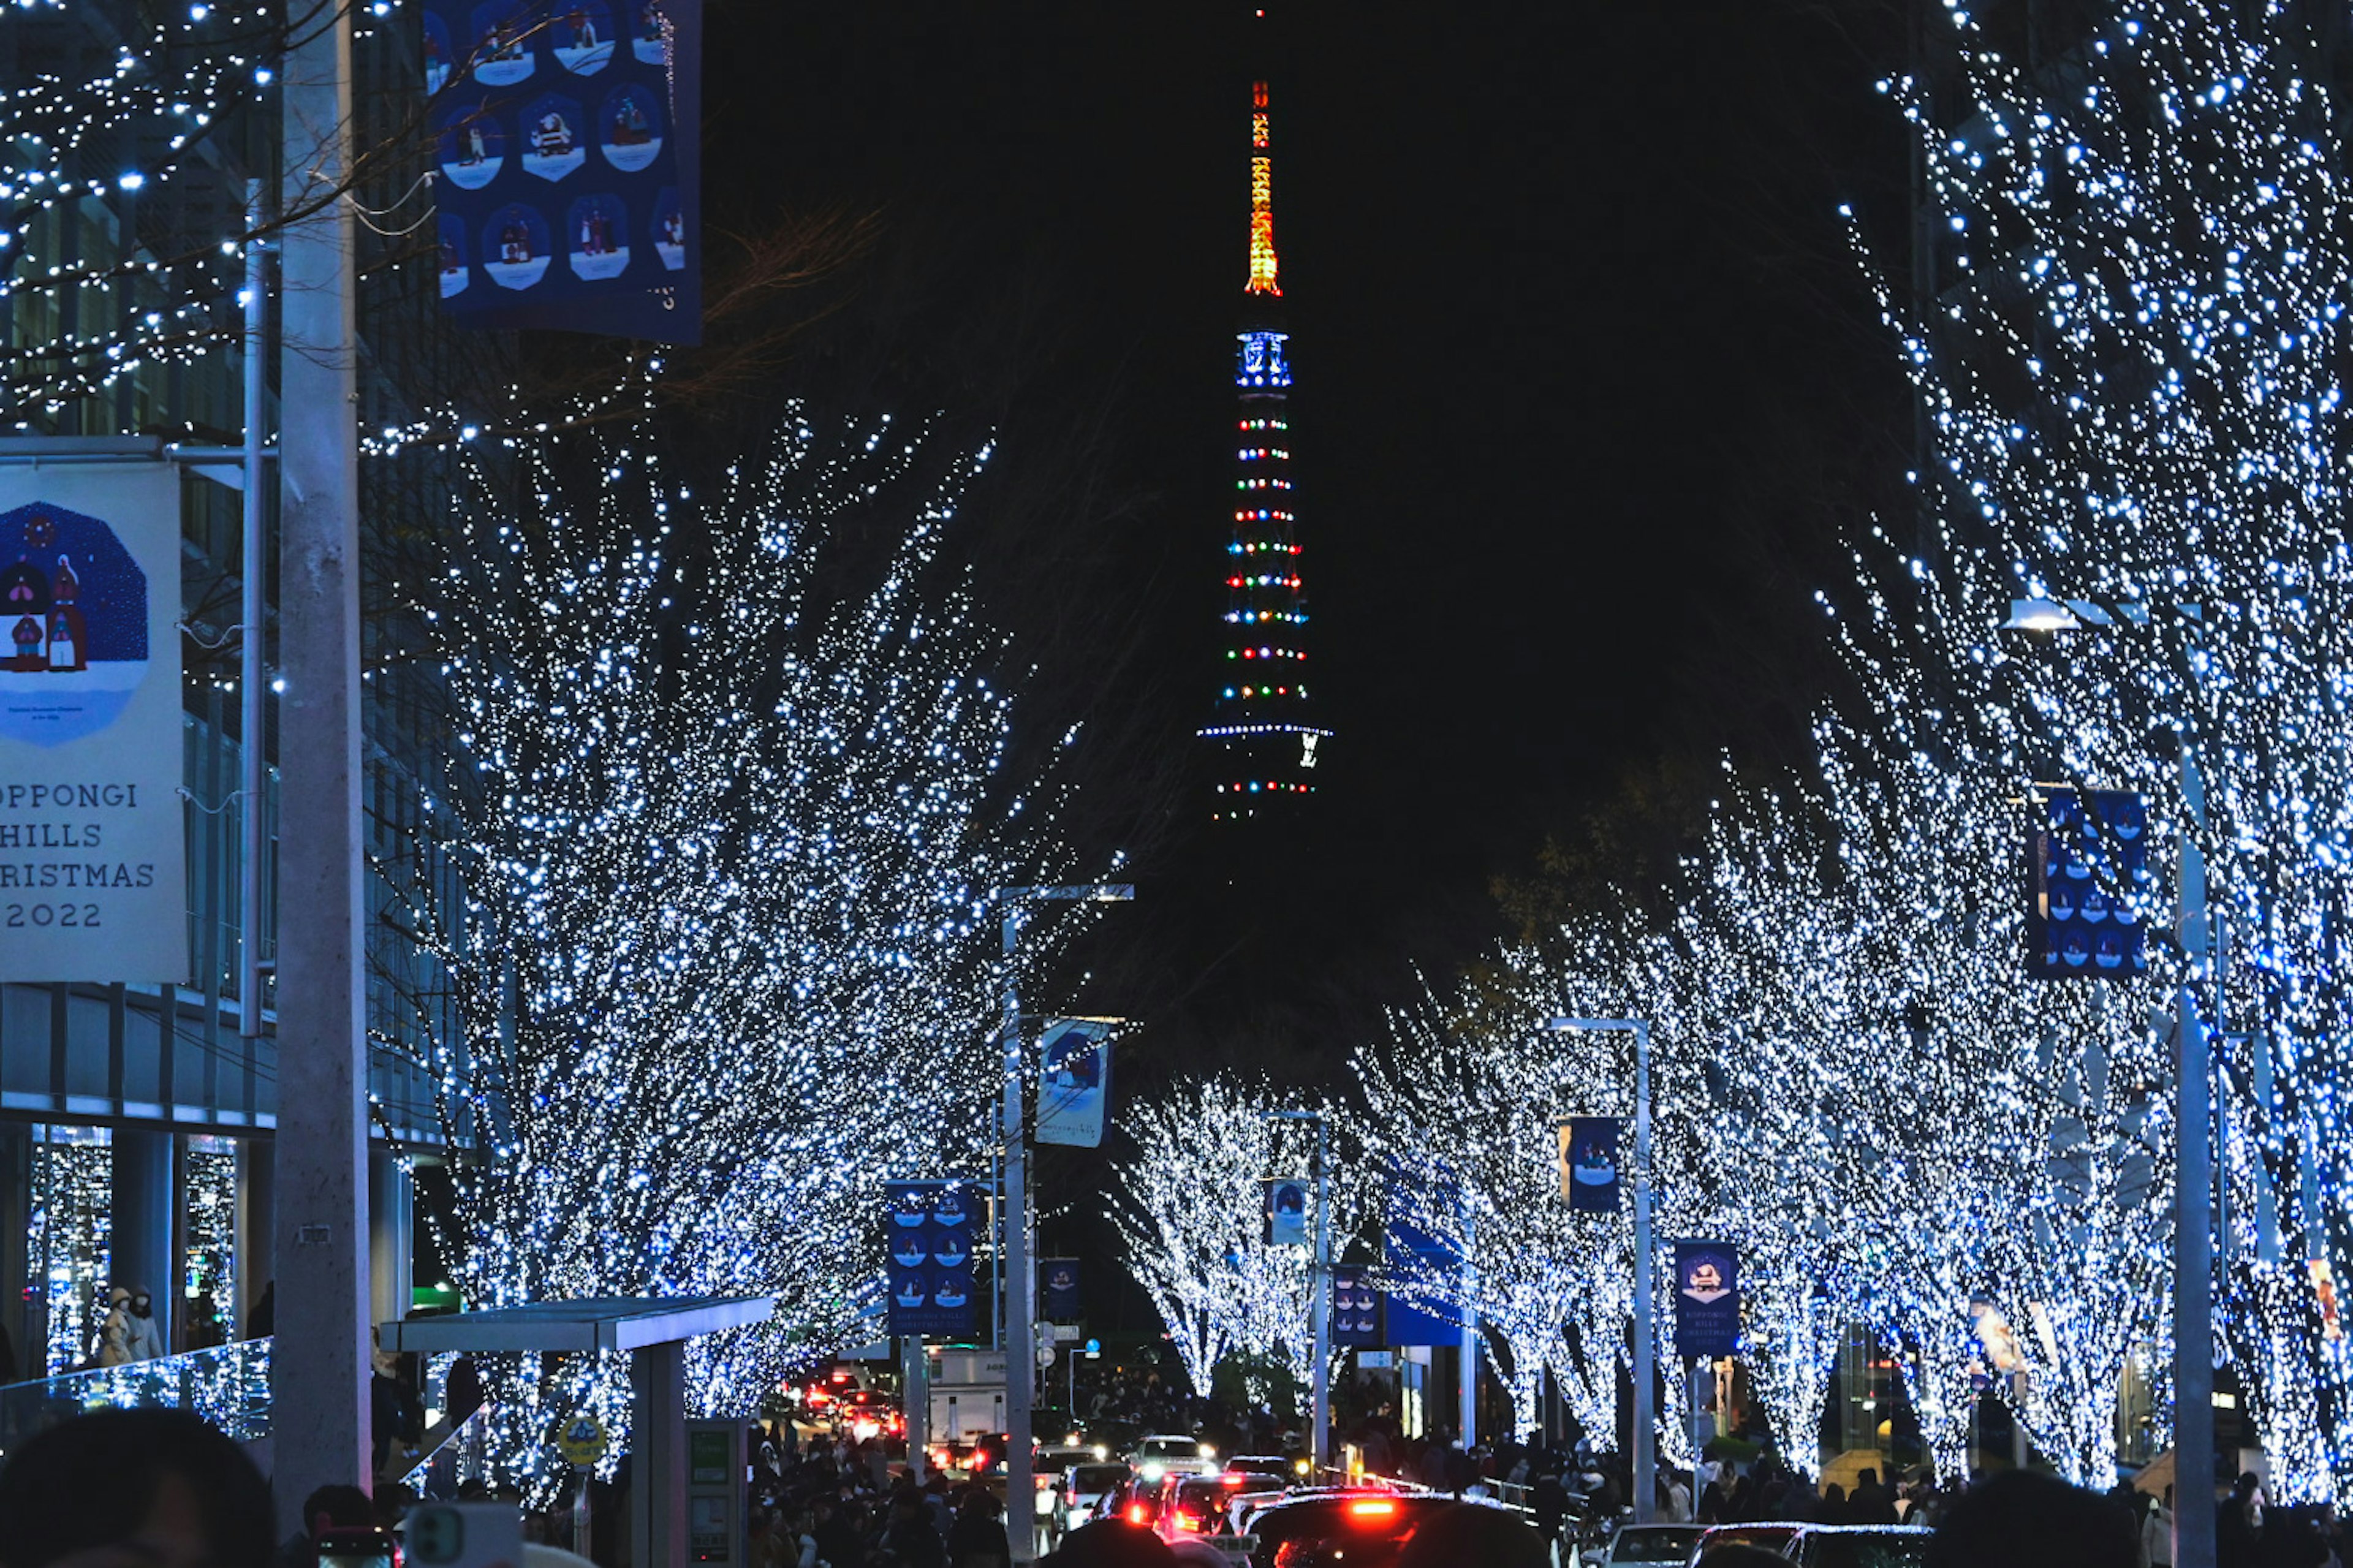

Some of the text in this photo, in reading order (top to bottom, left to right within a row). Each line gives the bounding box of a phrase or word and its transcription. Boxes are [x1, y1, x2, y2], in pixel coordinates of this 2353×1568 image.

[0, 784, 137, 808] PPONGI
[0, 824, 100, 848] HILLS
[7, 904, 100, 928] 2022
